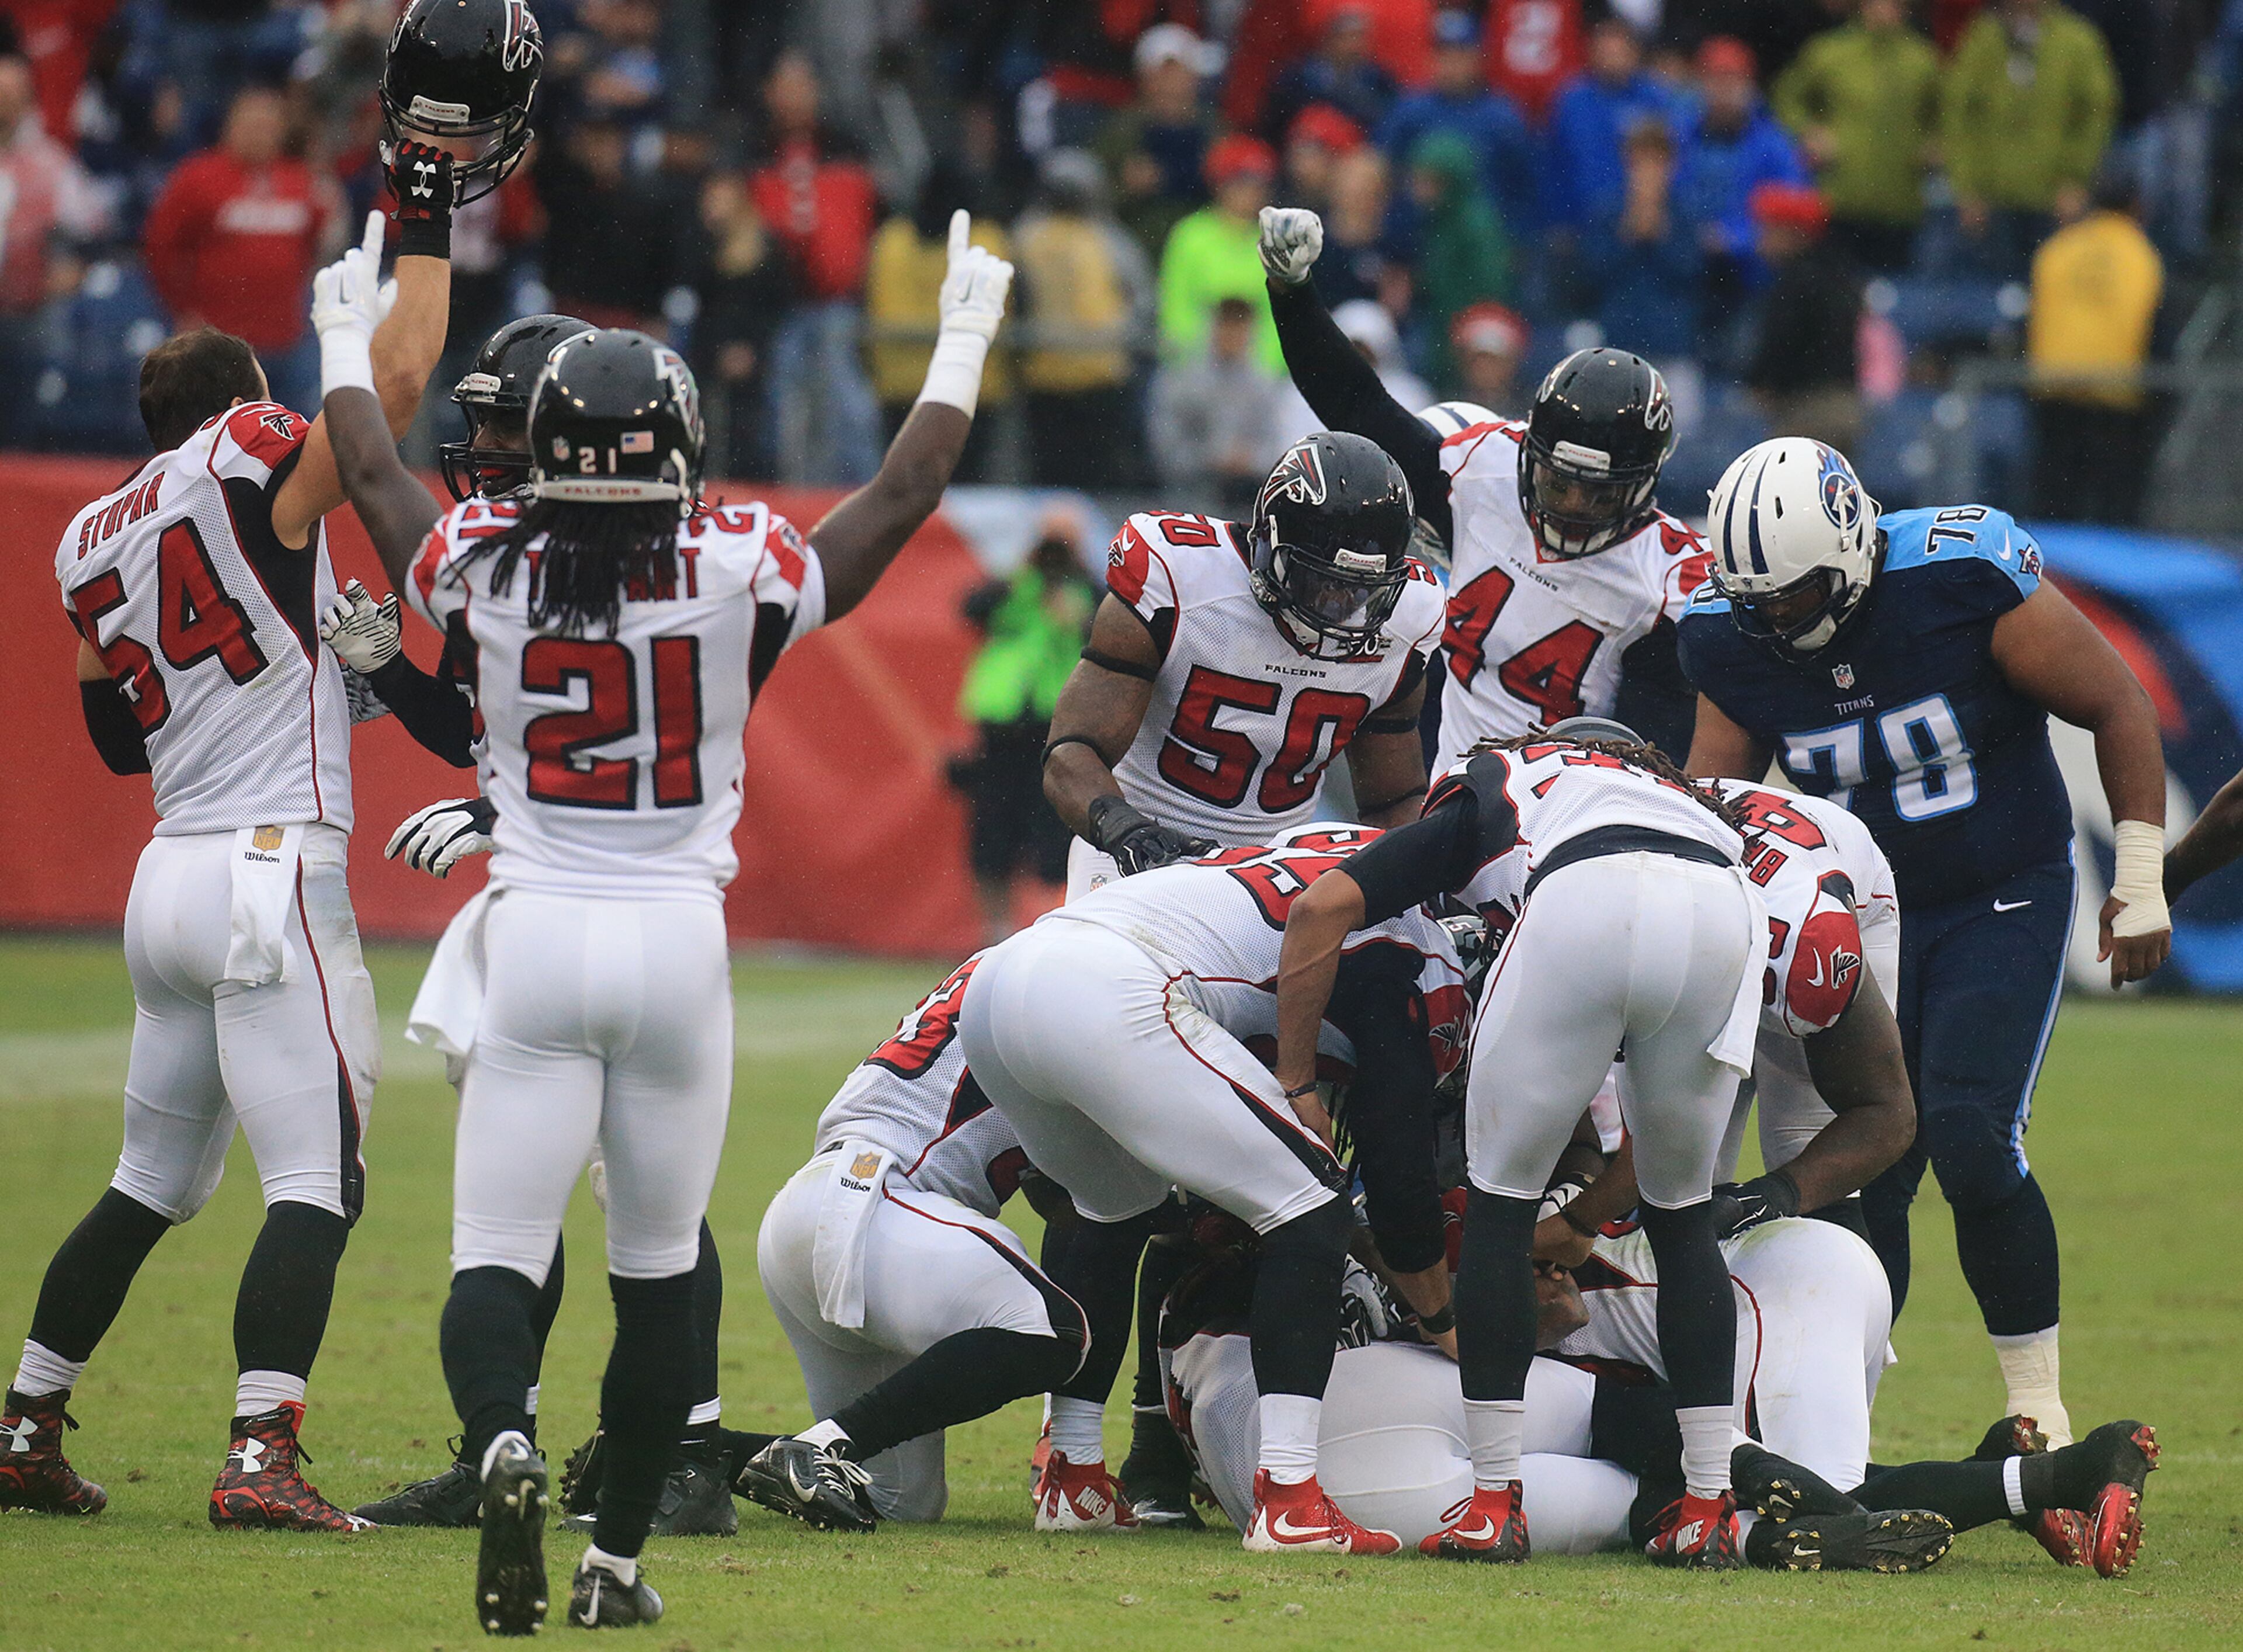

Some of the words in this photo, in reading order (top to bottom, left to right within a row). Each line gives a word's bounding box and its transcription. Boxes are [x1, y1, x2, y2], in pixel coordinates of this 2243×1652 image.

[579, 446, 617, 474] 21
[564, 485, 641, 496] FALCONS
[77, 471, 166, 561] STUPAR
[1509, 556, 1559, 592] FALCONS
[70, 516, 271, 734] 54
[1440, 565, 1605, 727] 44
[1265, 664, 1327, 679] FALCONS
[520, 634, 703, 811] 21
[1834, 694, 1875, 716] TITANS
[1157, 664, 1370, 813] 50
[1782, 692, 1979, 822] 78
[244, 851, 280, 864] Wilson
[1075, 1485, 1107, 1518] NIKE
[1675, 1519, 1705, 1554] NIKE
